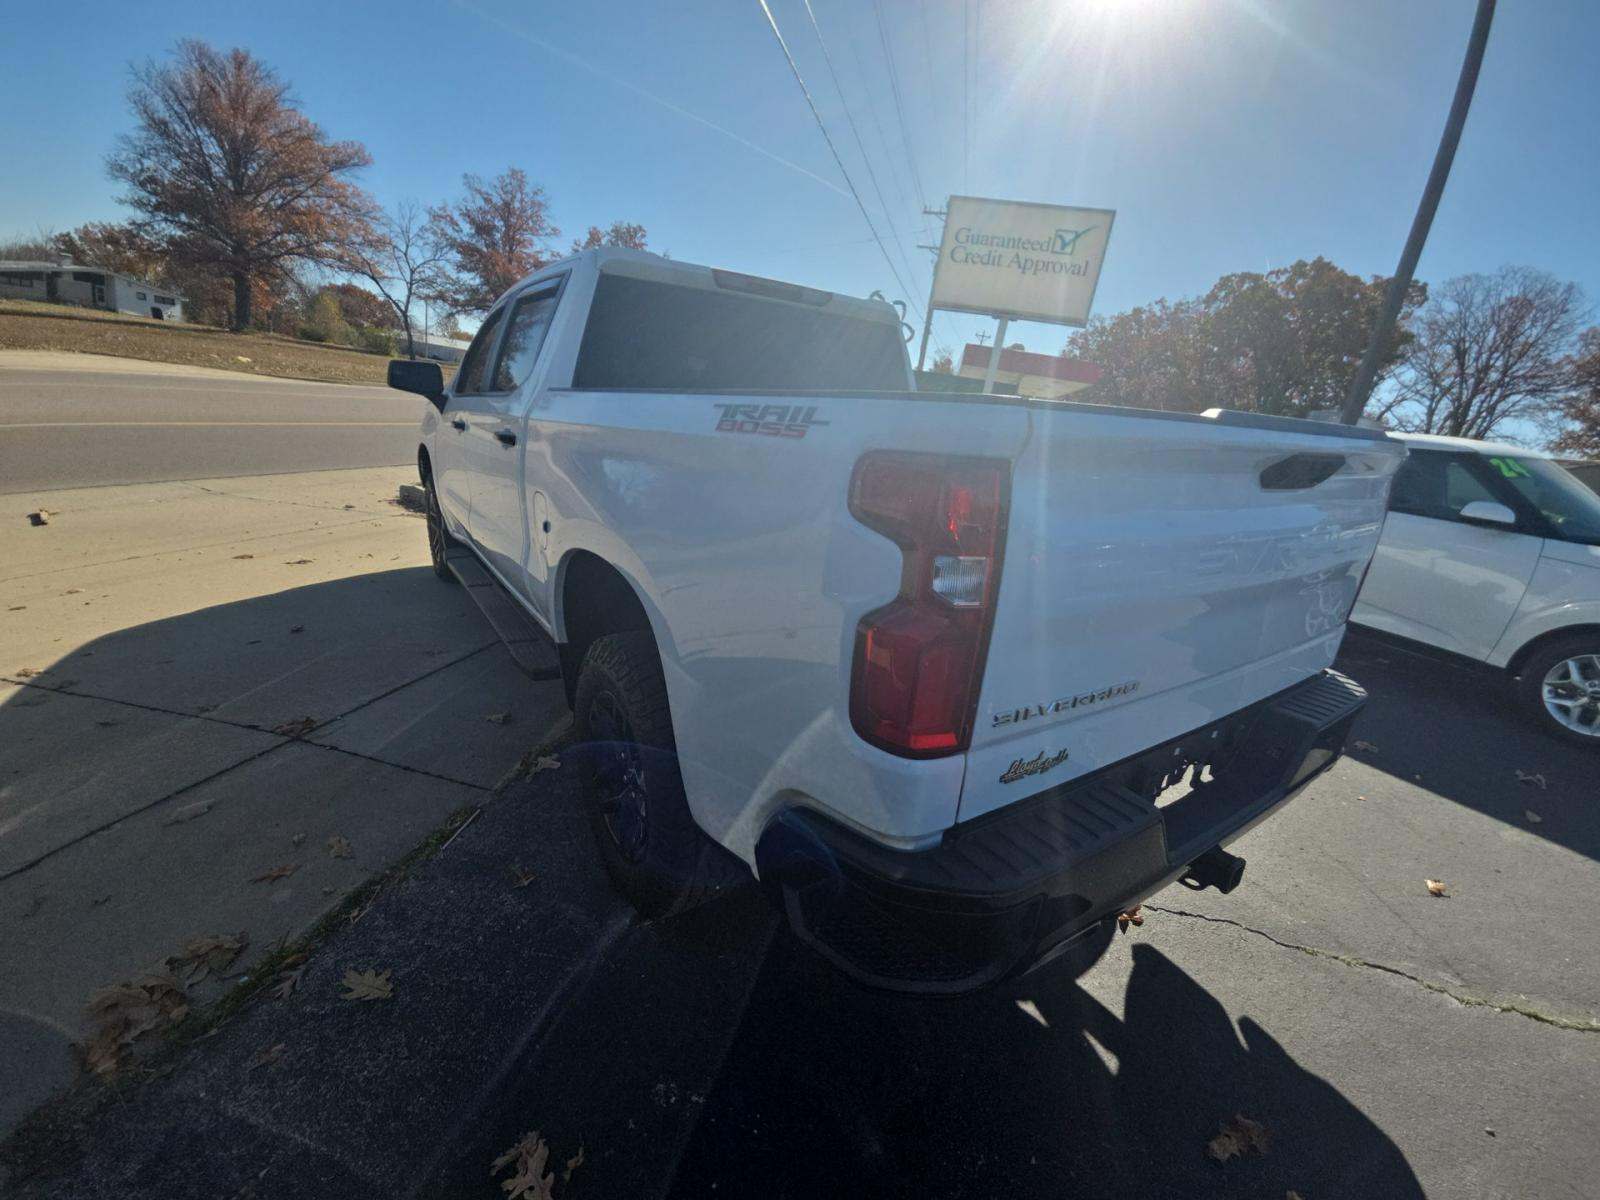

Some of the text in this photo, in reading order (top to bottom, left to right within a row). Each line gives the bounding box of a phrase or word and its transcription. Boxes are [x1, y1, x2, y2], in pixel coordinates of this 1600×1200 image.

[954, 227, 1052, 252] Guaranteed
[950, 245, 1089, 277] Credit Approval
[713, 403, 831, 426] TRAIL
[992, 680, 1141, 728] SILVERADO
